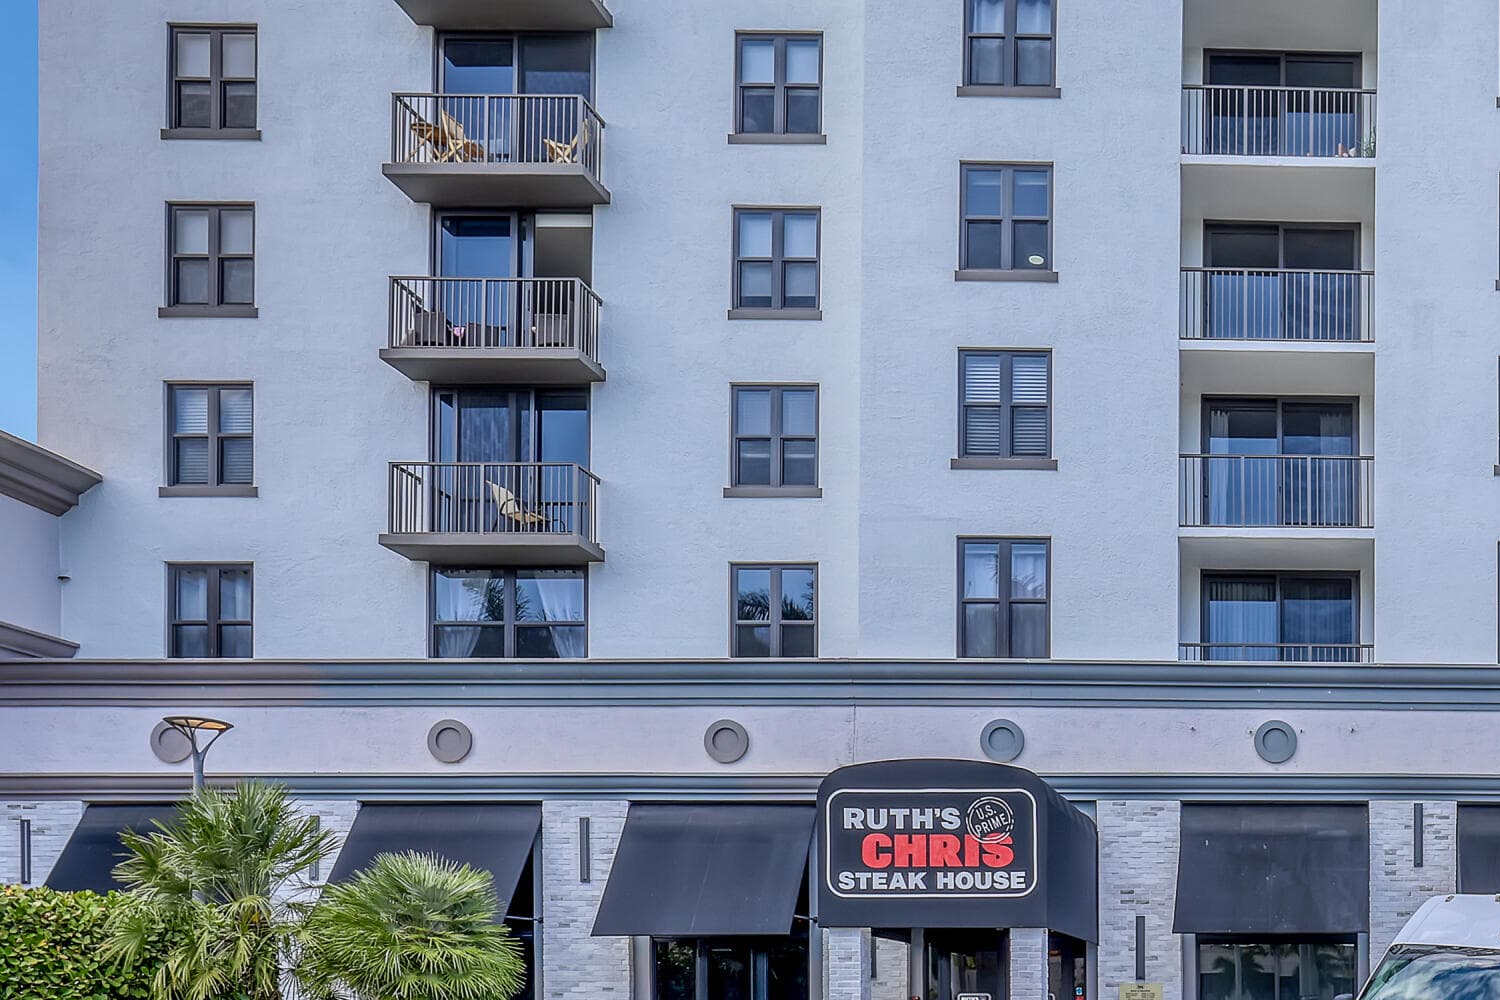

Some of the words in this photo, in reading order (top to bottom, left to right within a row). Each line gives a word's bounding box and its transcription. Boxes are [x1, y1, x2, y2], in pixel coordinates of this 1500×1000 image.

[843, 807, 961, 830] RUTH'S
[975, 804, 997, 821] U.S.
[974, 813, 1009, 837] PRIME
[861, 833, 1015, 868] CHRIS
[838, 871, 928, 890] STEAK
[936, 871, 1026, 890] HOUSE
